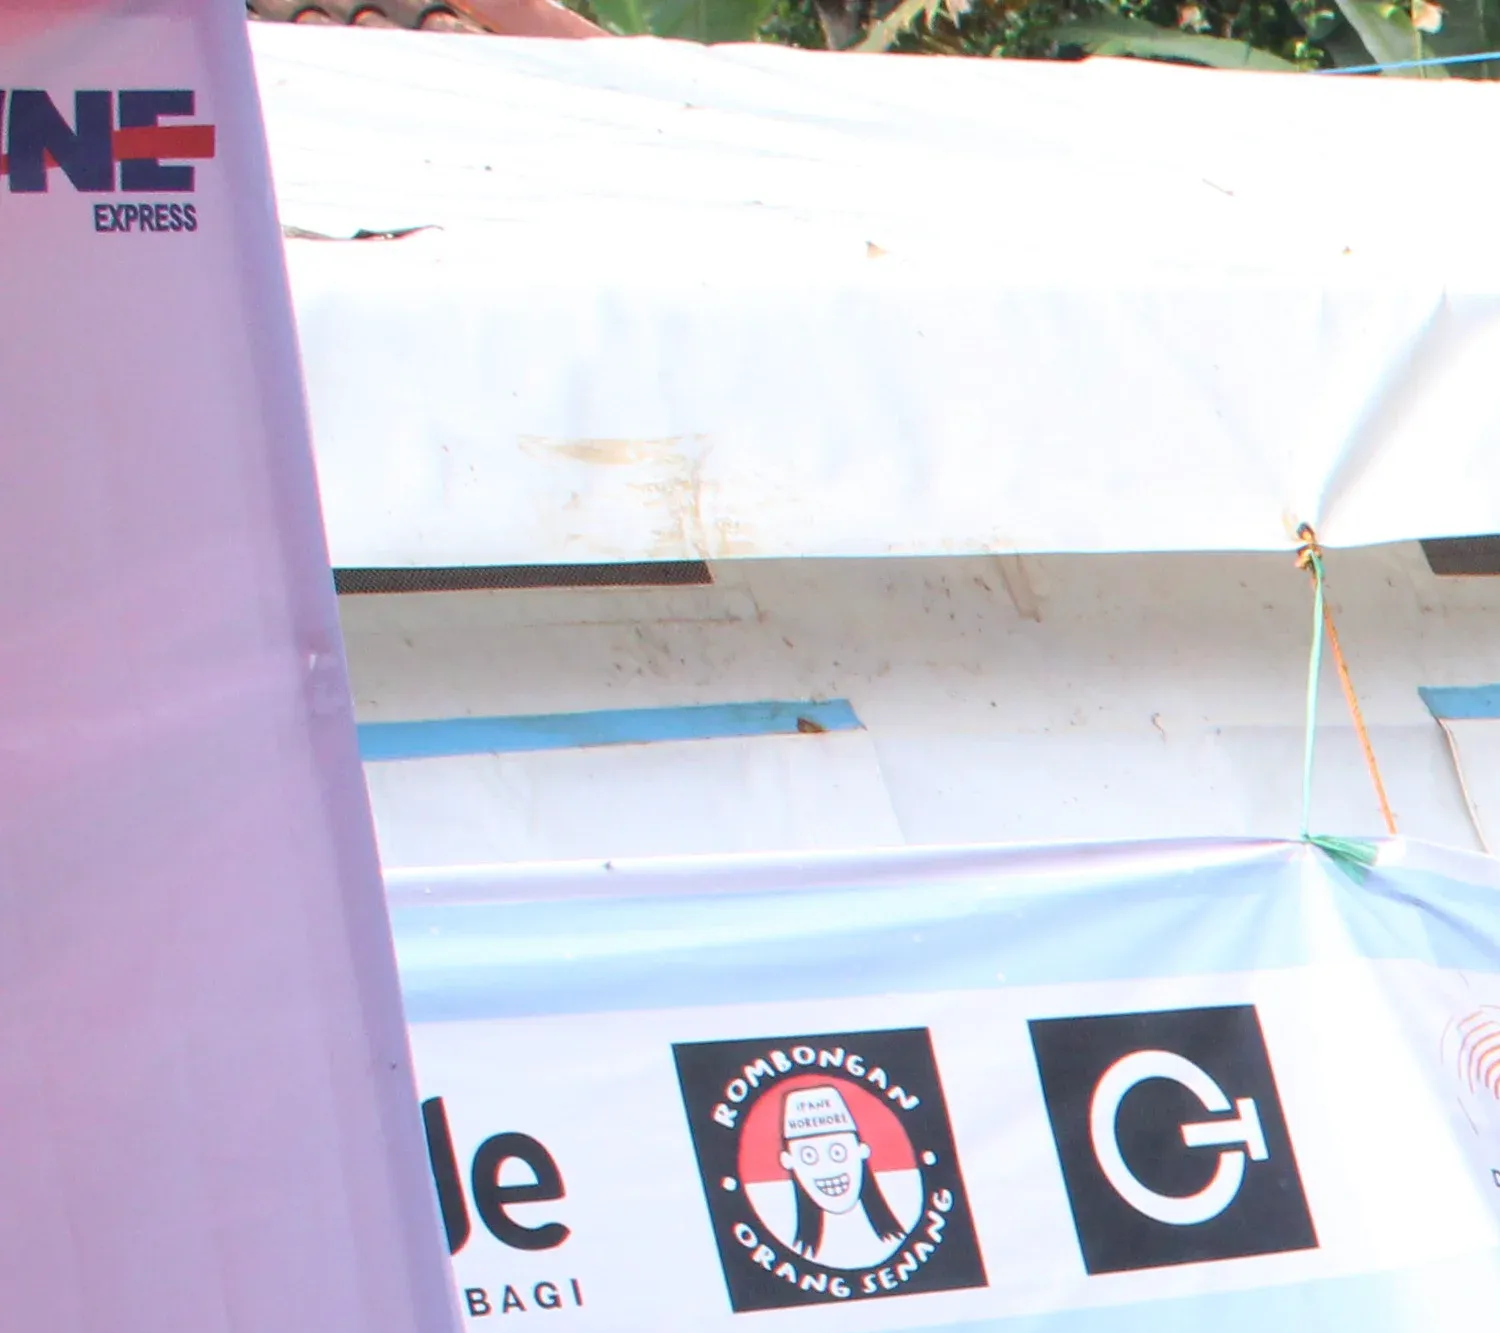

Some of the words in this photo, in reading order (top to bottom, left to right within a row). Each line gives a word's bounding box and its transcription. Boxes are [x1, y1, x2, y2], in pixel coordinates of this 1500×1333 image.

[0, 89, 215, 193] NE
[93, 203, 198, 232] EXPRESS
[712, 1046, 920, 1128] ROMBONGAN
[732, 1221, 851, 1298] ORANG
[861, 1189, 954, 1294] SENANG
[464, 1277, 584, 1317] BAGI
